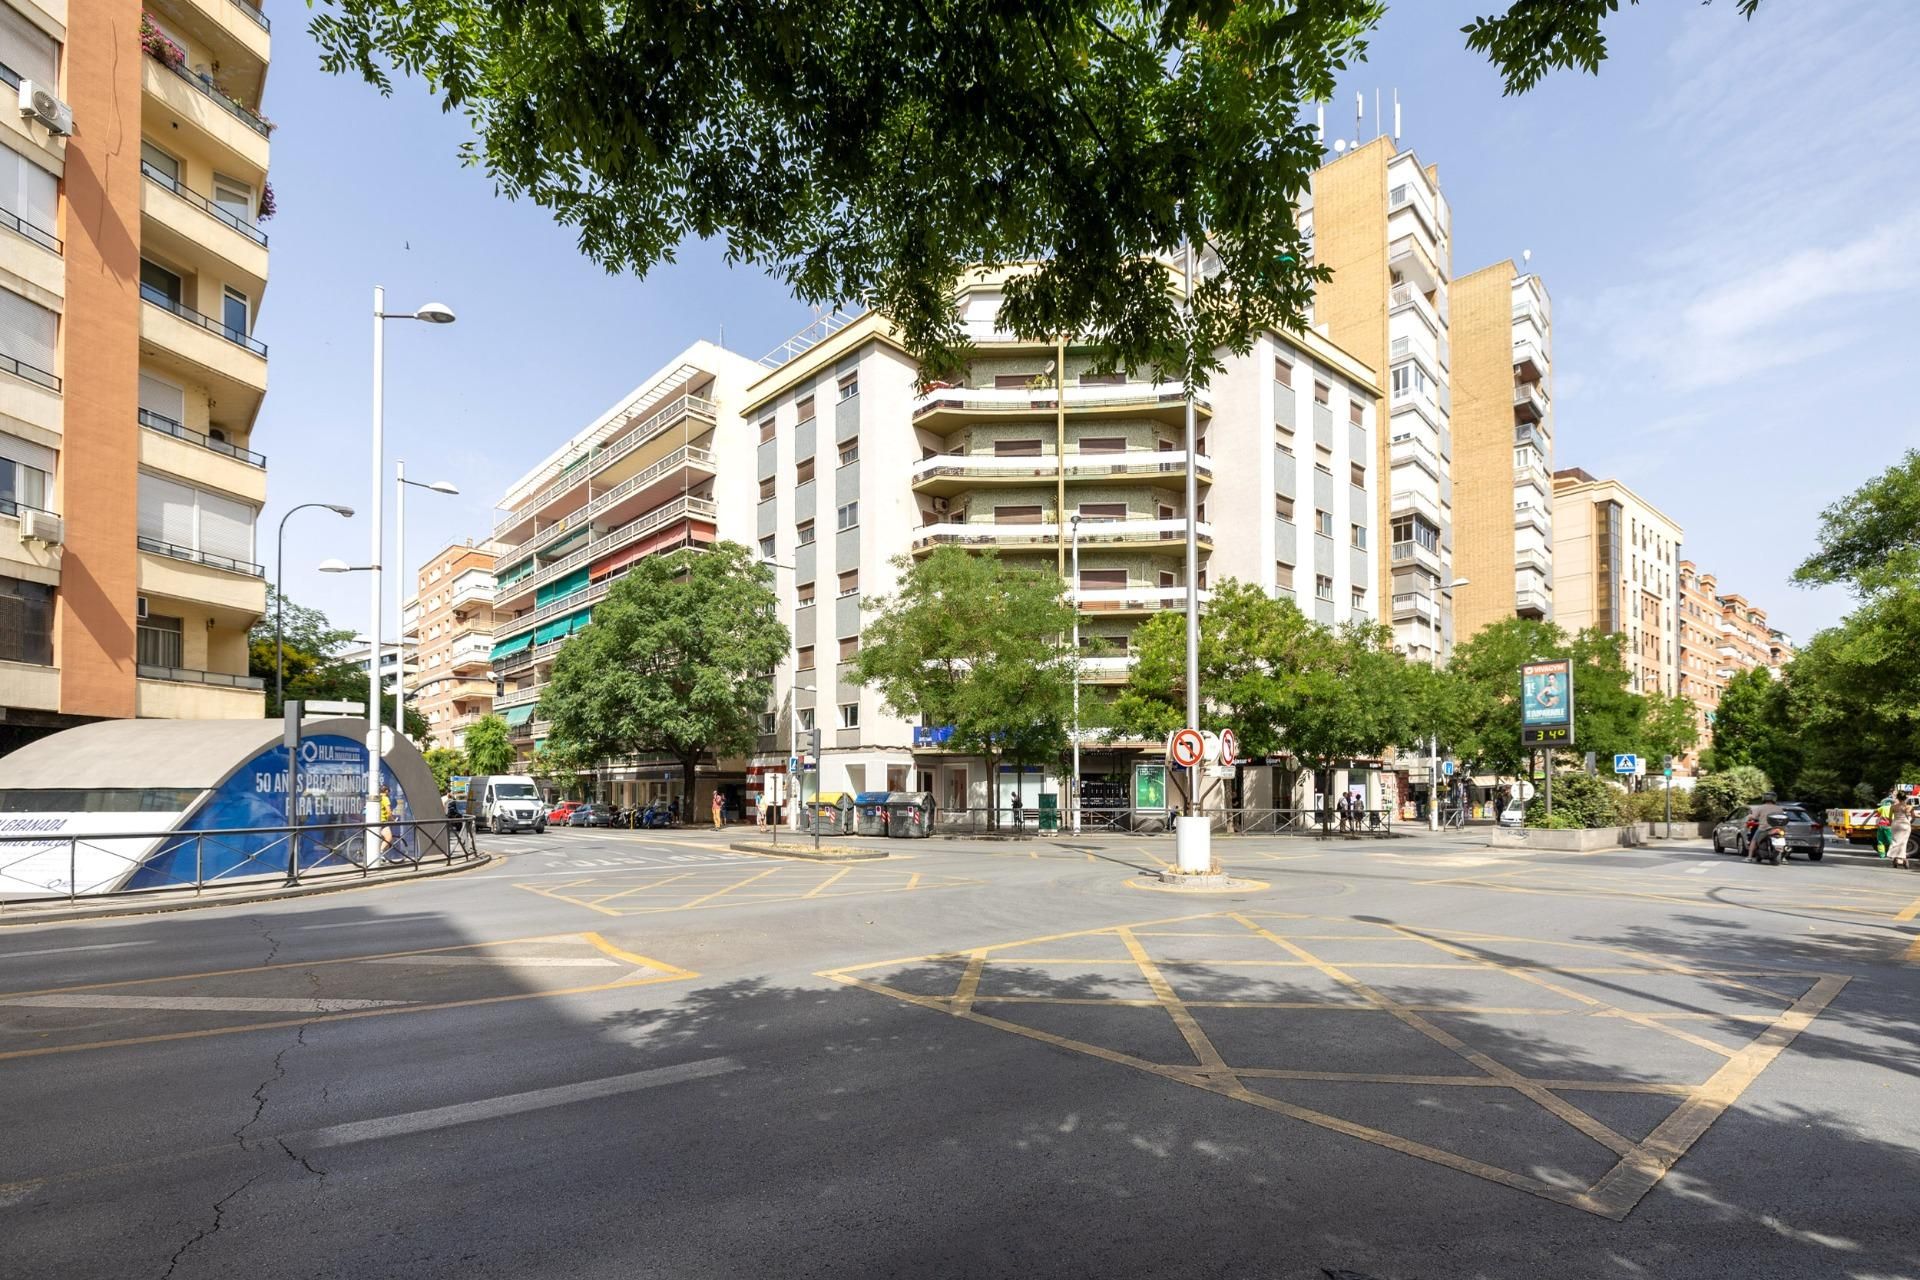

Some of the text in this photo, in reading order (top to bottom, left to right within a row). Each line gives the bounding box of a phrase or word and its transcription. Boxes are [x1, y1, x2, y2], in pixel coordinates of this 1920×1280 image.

[1534, 664, 1564, 673] VIVAGYM
[319, 745, 334, 760] HLA
[256, 769, 369, 793] 50 AÑS PREPARANDO
[315, 797, 325, 815] EL
[328, 797, 361, 814] FUTURO
[1, 819, 67, 831] GRANADA
